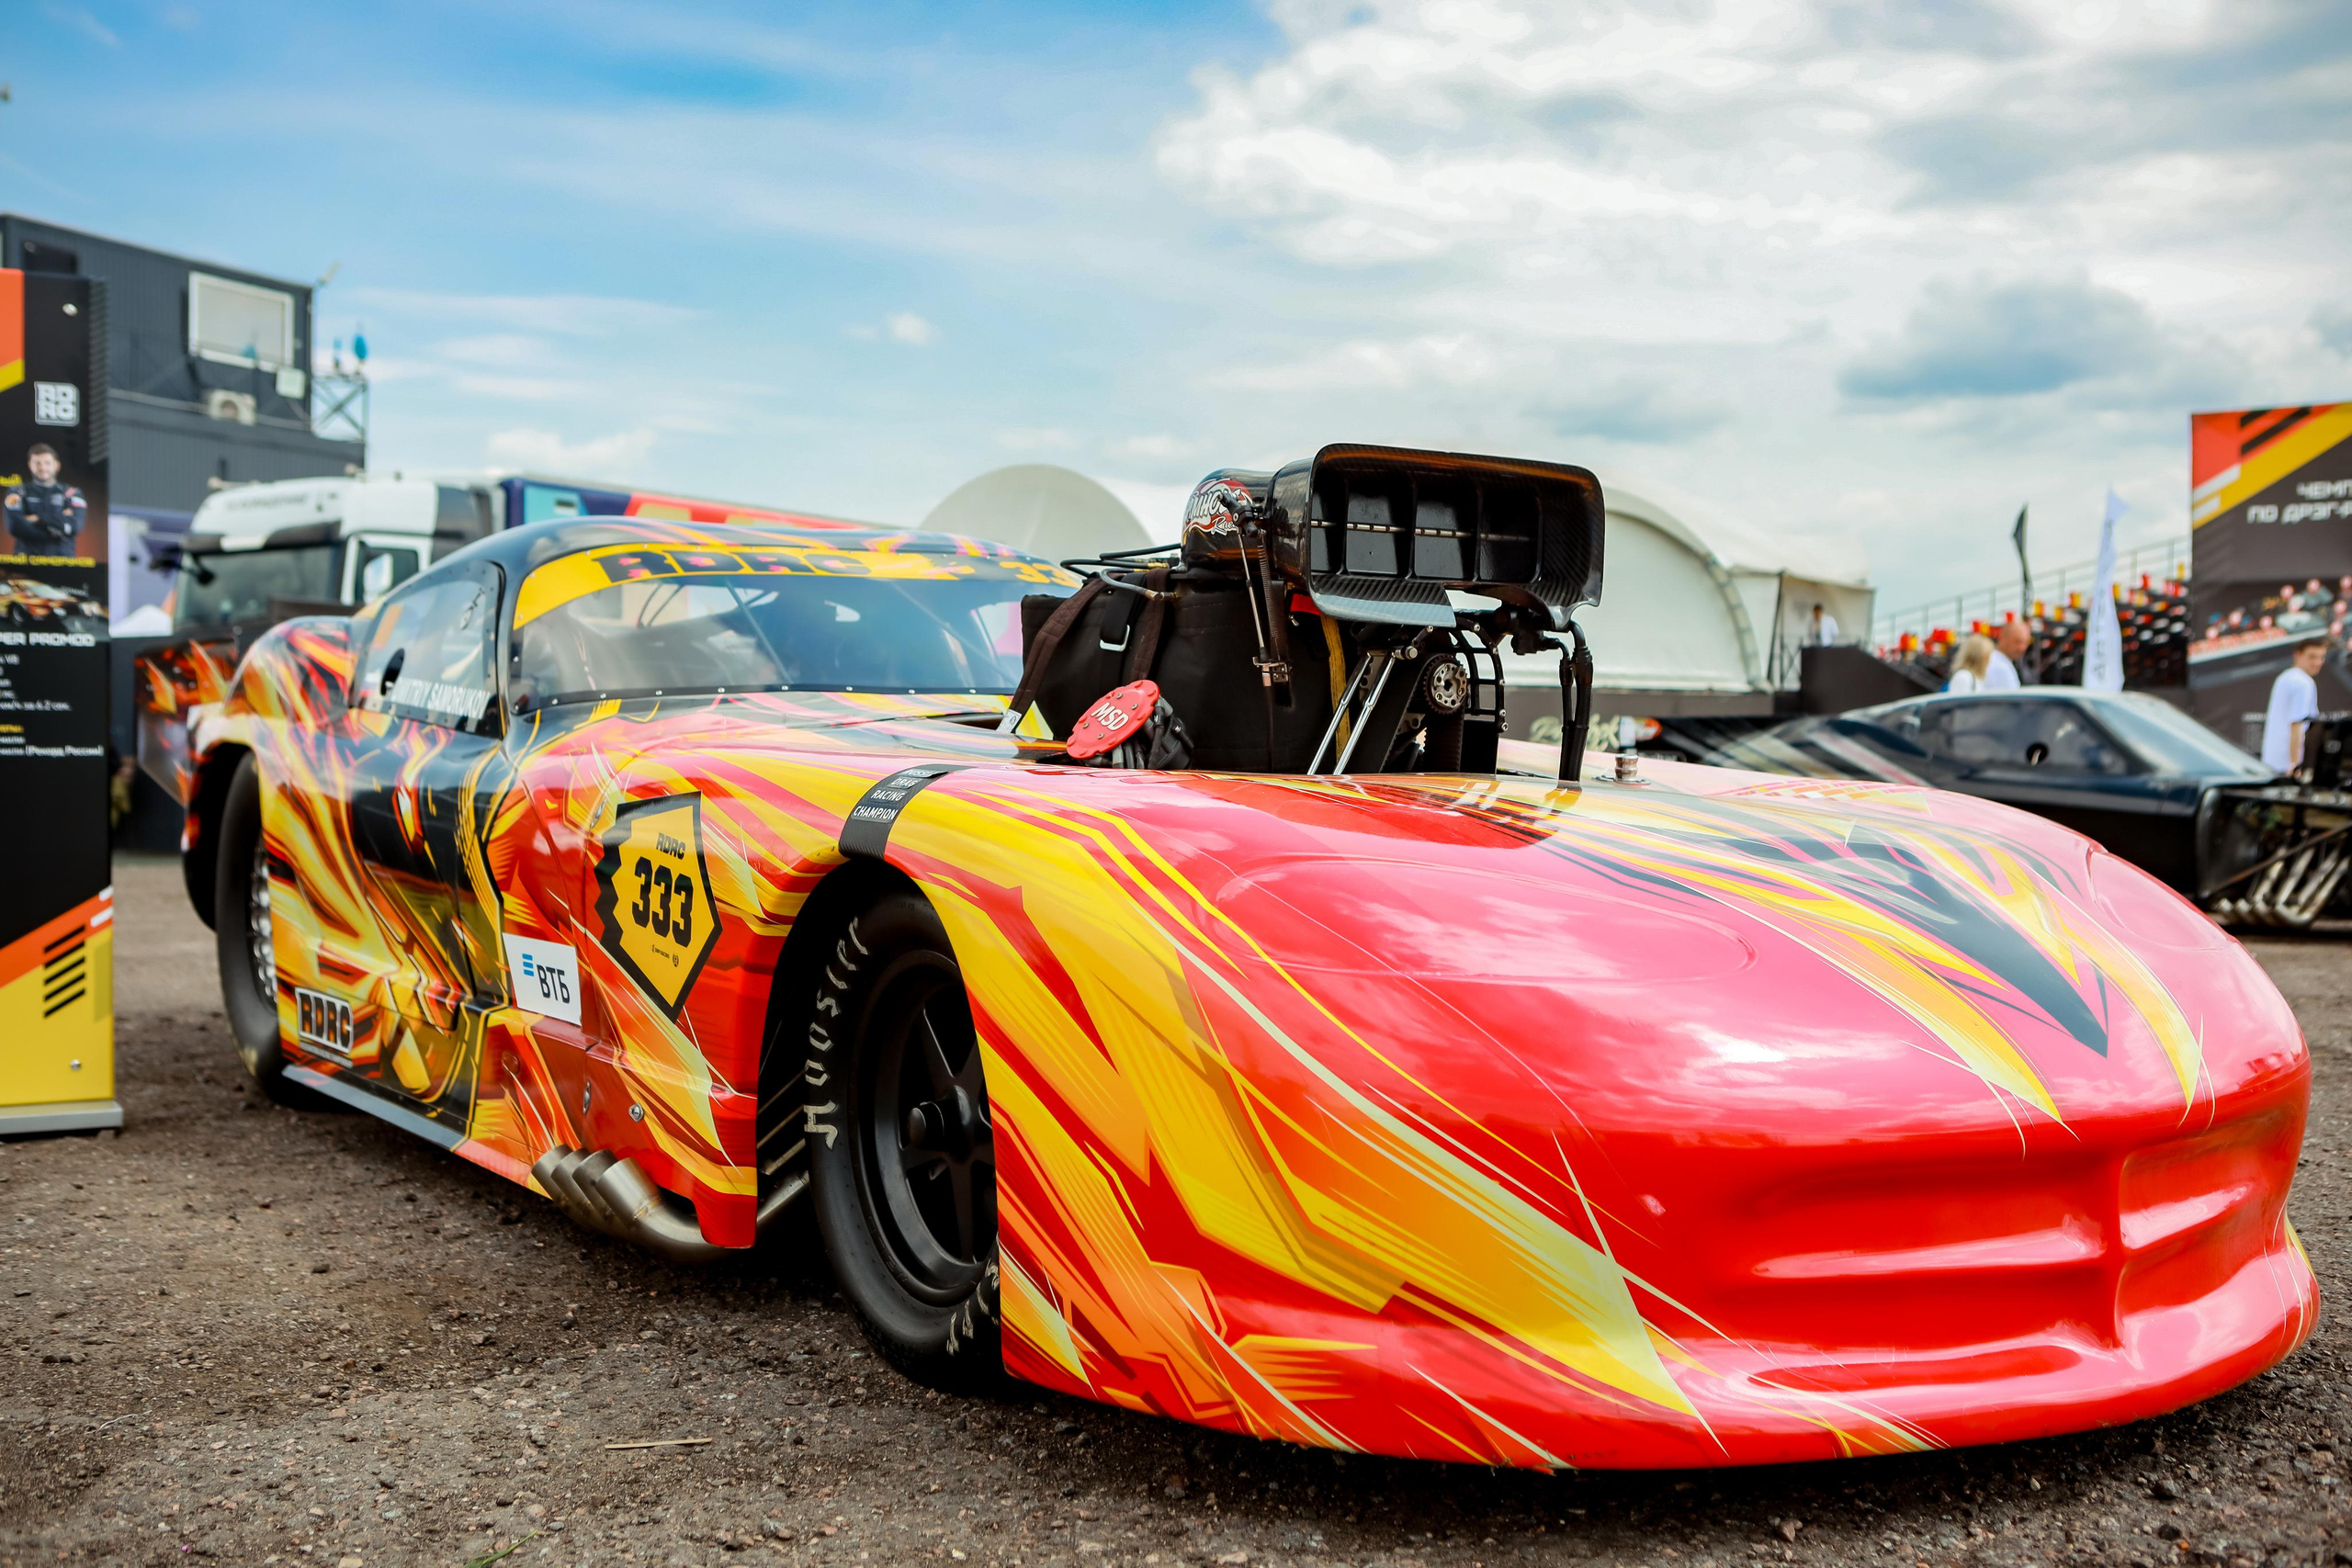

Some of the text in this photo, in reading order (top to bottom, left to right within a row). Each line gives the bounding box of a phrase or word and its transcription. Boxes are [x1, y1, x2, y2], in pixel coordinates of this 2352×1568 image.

[2246, 503, 2278, 525] ПО
[28, 632, 96, 647] PROMOD
[1091, 701, 1130, 731] MSD
[891, 778, 918, 787] DRAG
[870, 790, 905, 801] RACING
[853, 805, 899, 820] CHAMPION
[656, 832, 686, 860] RDRC
[631, 855, 694, 948] 333
[537, 964, 571, 1004] ВТБ
[298, 990, 353, 1050] RDRC
